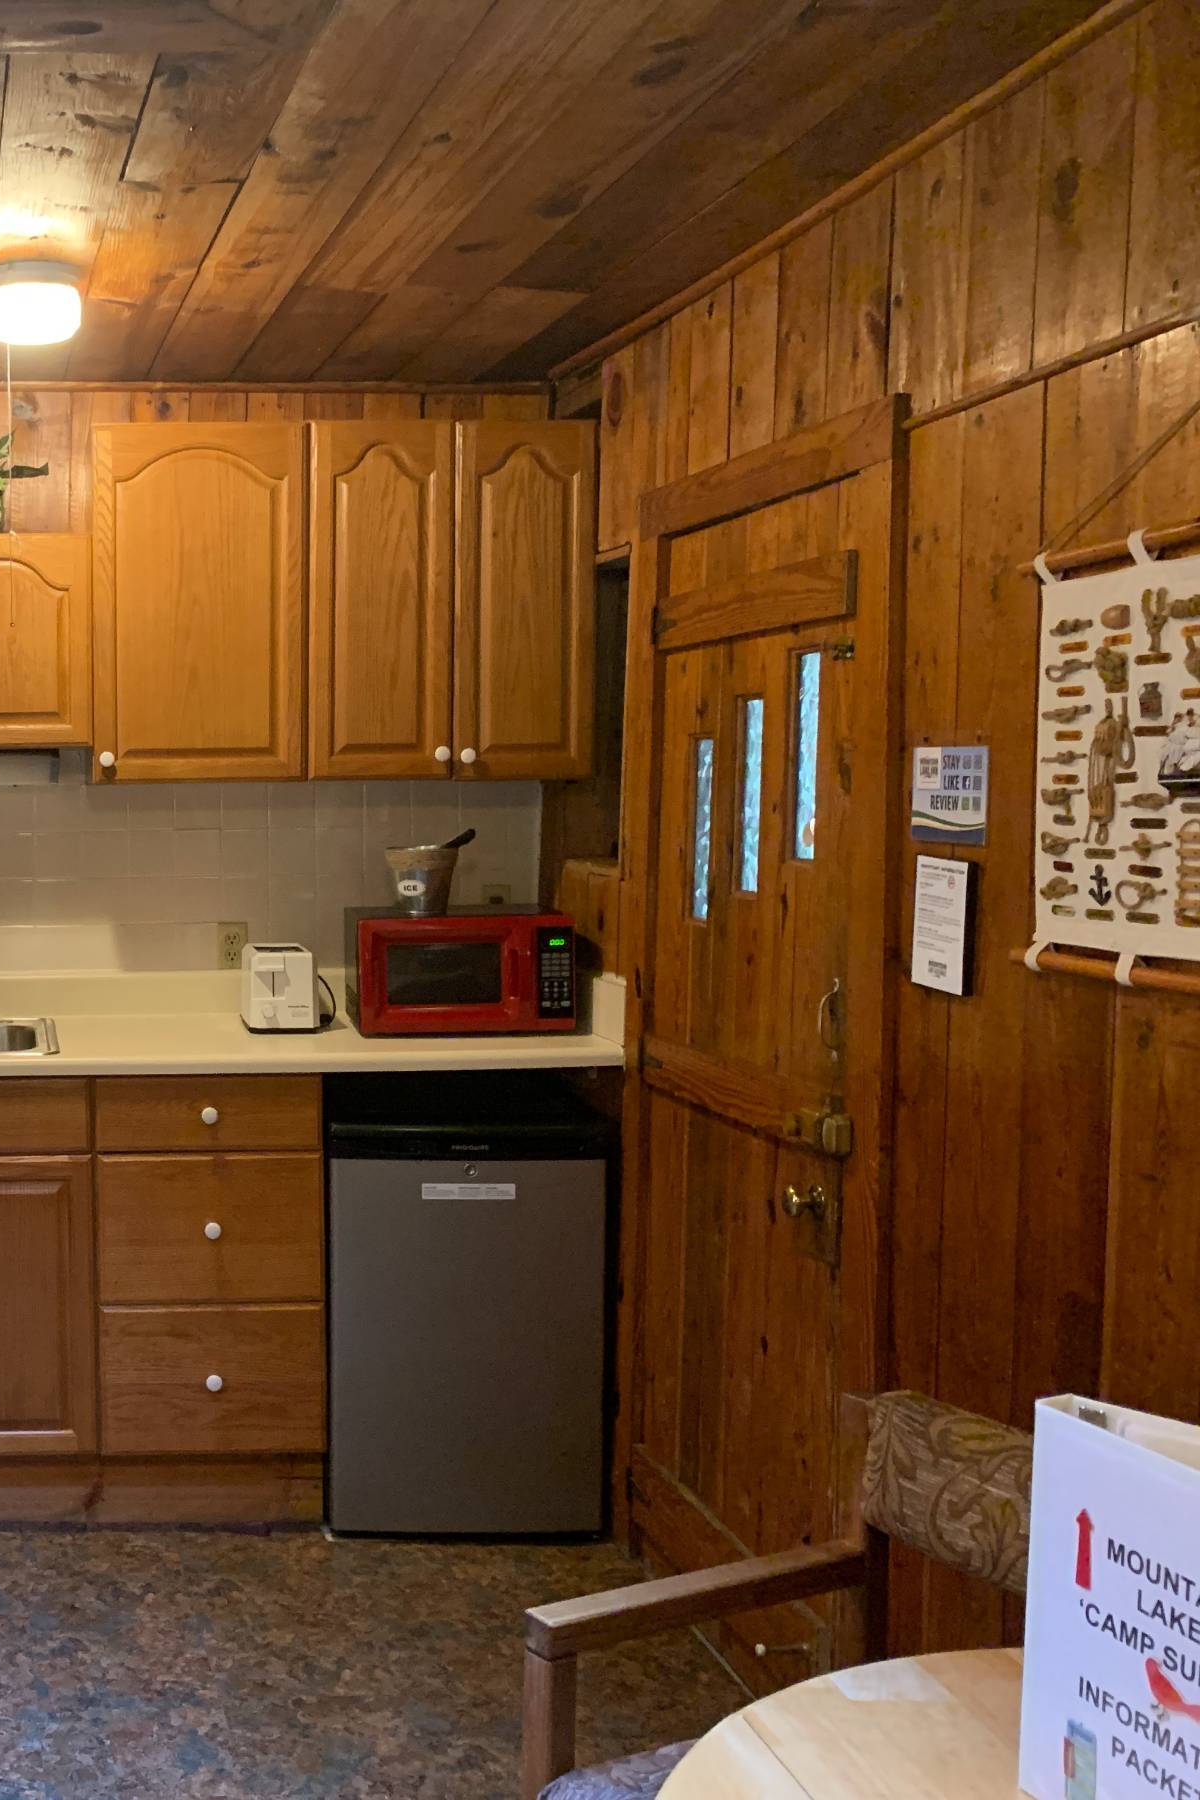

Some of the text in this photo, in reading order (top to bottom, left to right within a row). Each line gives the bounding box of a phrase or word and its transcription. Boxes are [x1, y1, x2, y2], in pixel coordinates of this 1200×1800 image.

[943, 754, 960, 771] STAY
[943, 774, 960, 791] LIKE
[930, 794, 960, 811] REVIEW
[403, 884, 418, 892] ICE
[1137, 1588, 1200, 1645] LAKE
[1162, 1645, 1200, 1687] SU
